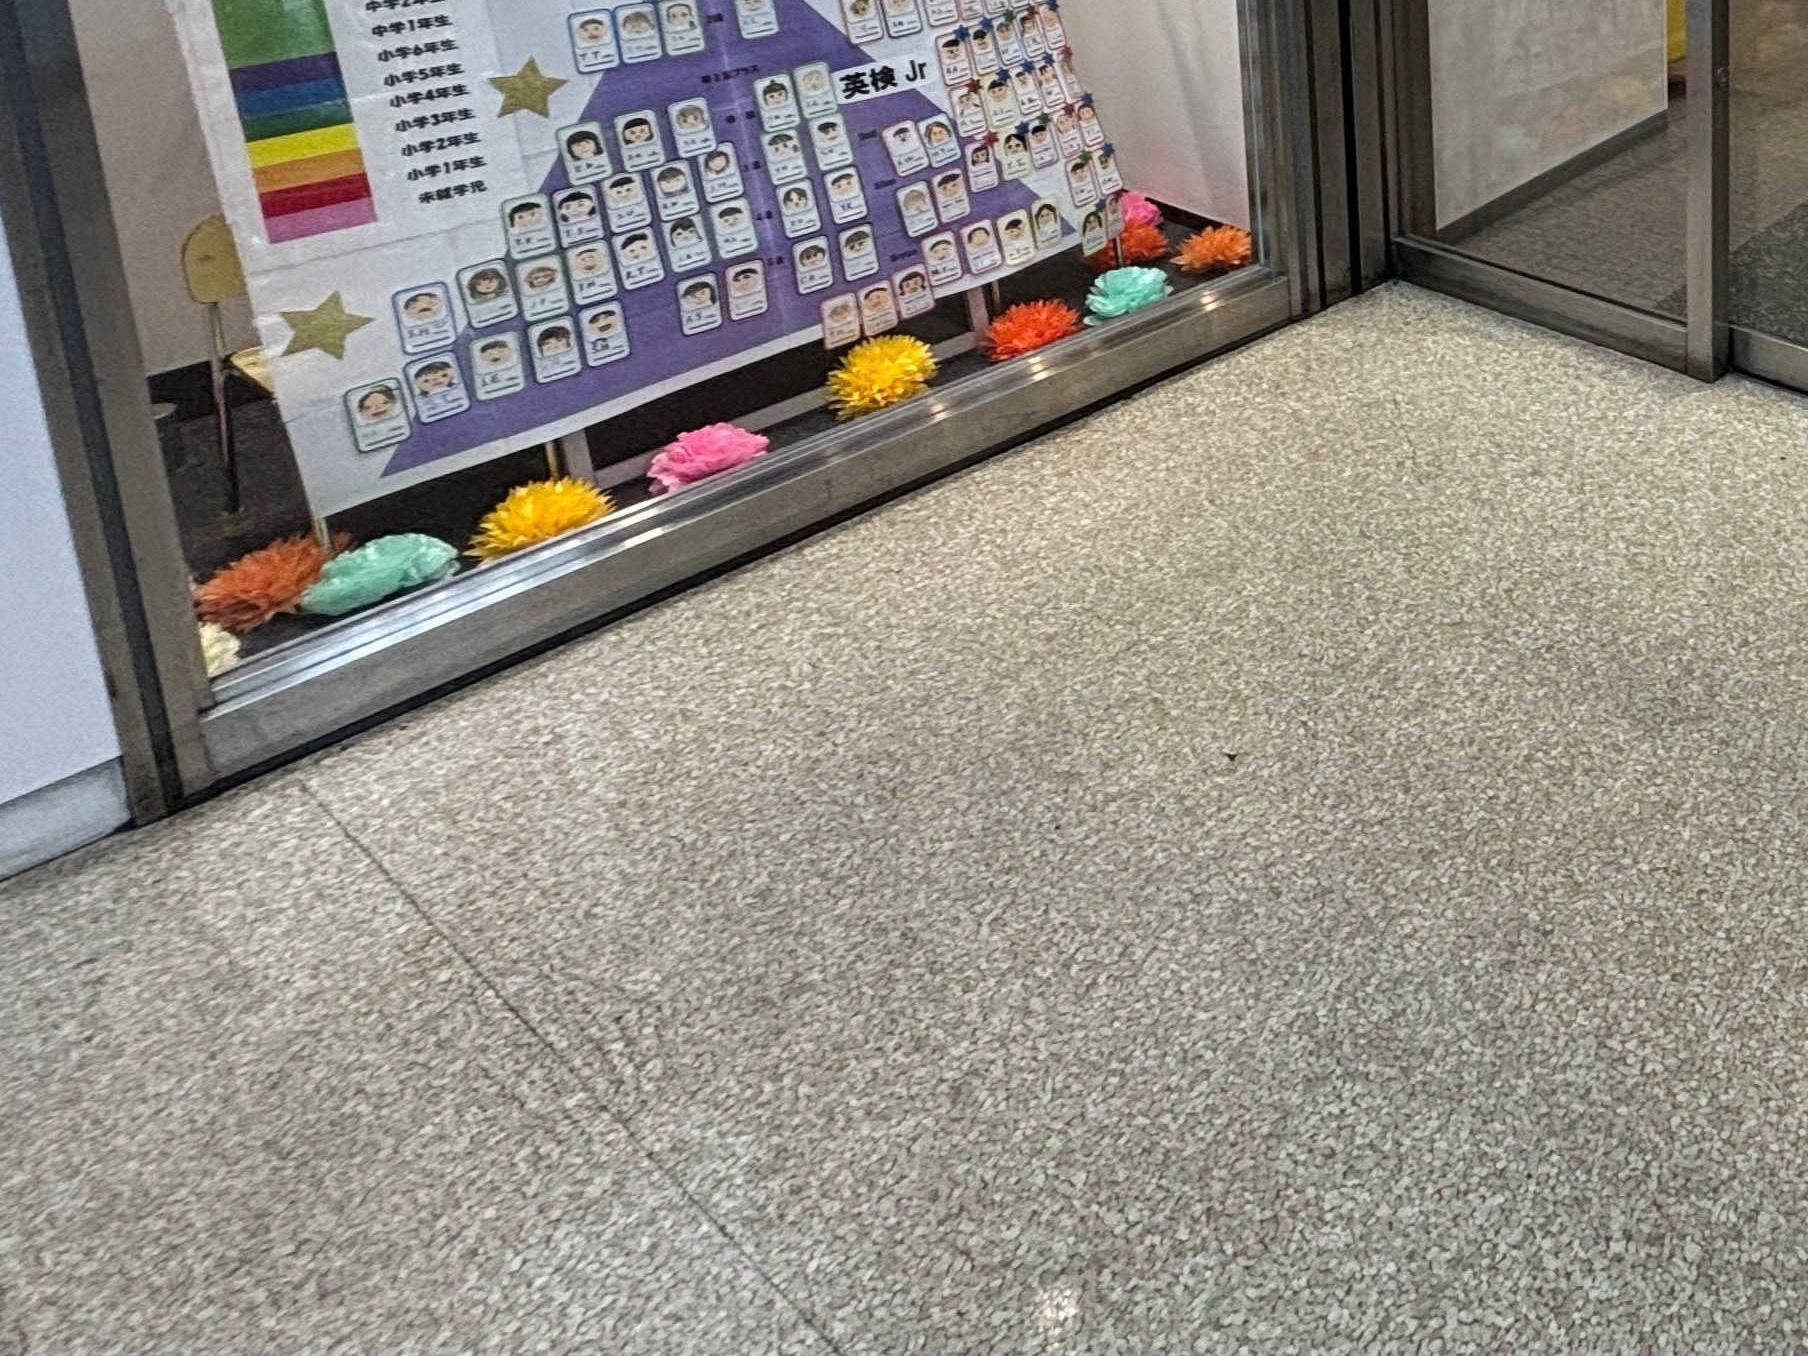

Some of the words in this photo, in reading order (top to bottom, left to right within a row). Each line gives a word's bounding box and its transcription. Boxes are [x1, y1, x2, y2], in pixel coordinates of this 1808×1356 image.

[371, 14, 452, 38] 中学1年生
[377, 38, 458, 64] 小学6年生
[383, 62, 464, 88] 小学5年生
[839, 65, 899, 100] 英検
[904, 60, 927, 84] Jr
[389, 84, 470, 110] 小学4年生
[395, 107, 476, 133] 小学3年生
[401, 131, 482, 158] 小学2年生
[407, 155, 487, 182] 小学1年生
